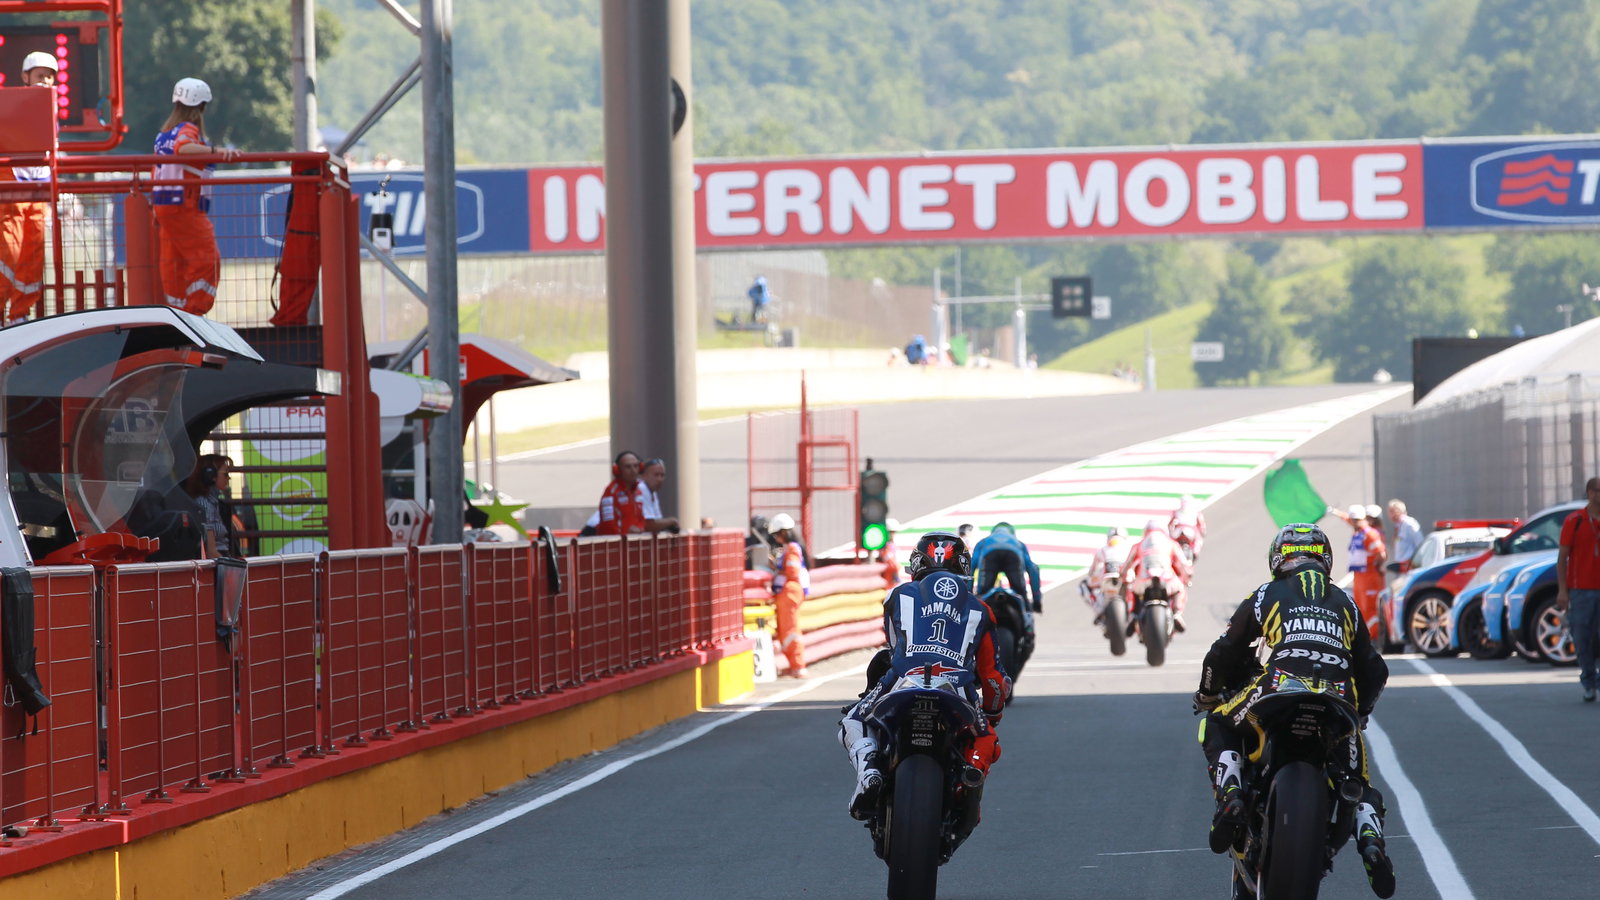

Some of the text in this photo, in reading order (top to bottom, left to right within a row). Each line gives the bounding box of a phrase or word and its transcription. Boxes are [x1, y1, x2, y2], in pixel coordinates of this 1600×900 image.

[543, 152, 1409, 244] IERNET MOBILE
[1281, 544, 1325, 556] CRUTCHLOW
[920, 602, 962, 624] YAMAHA
[1288, 604, 1339, 620] MONSTER
[928, 618, 949, 644] 1
[1283, 618, 1344, 641] YAMAHA
[1284, 633, 1343, 649] BRIDGESTONE
[907, 644, 965, 665] BRIDGESTONE
